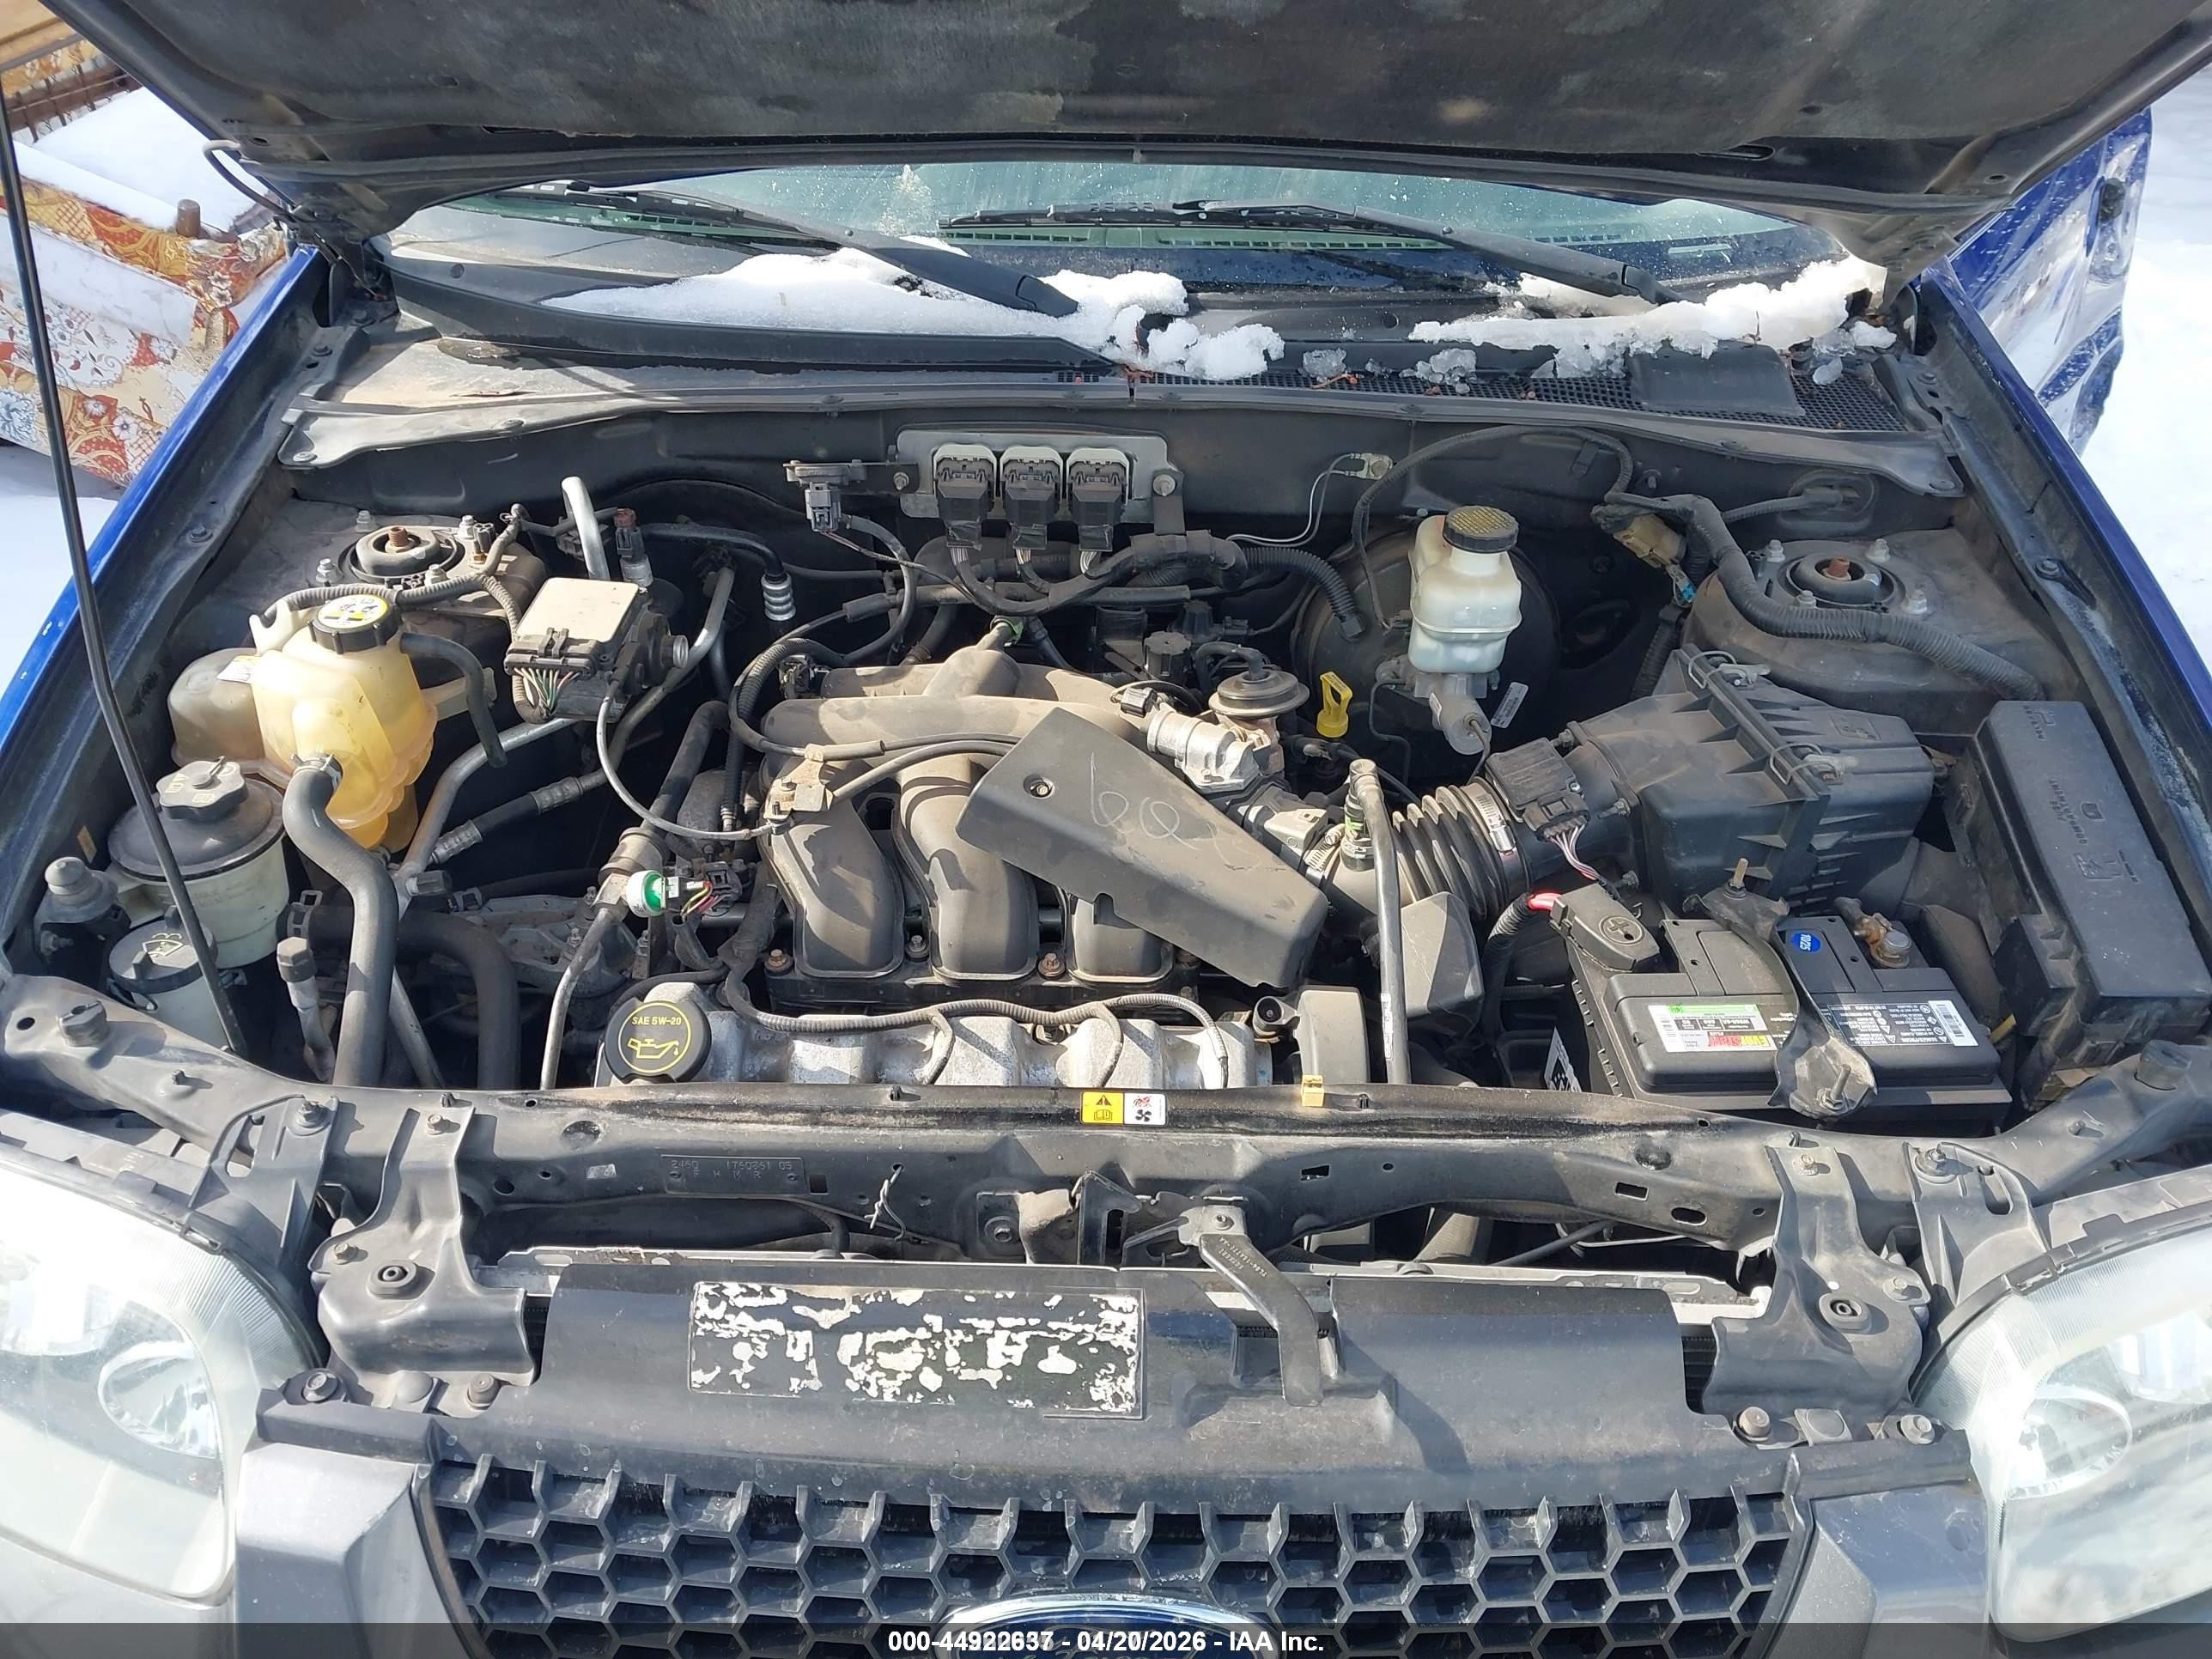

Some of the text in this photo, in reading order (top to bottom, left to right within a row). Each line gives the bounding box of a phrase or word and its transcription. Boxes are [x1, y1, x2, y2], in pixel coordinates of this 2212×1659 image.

[1799, 933, 1812, 951] 10/25
[631, 1016, 682, 1025] SAE 5W-20
